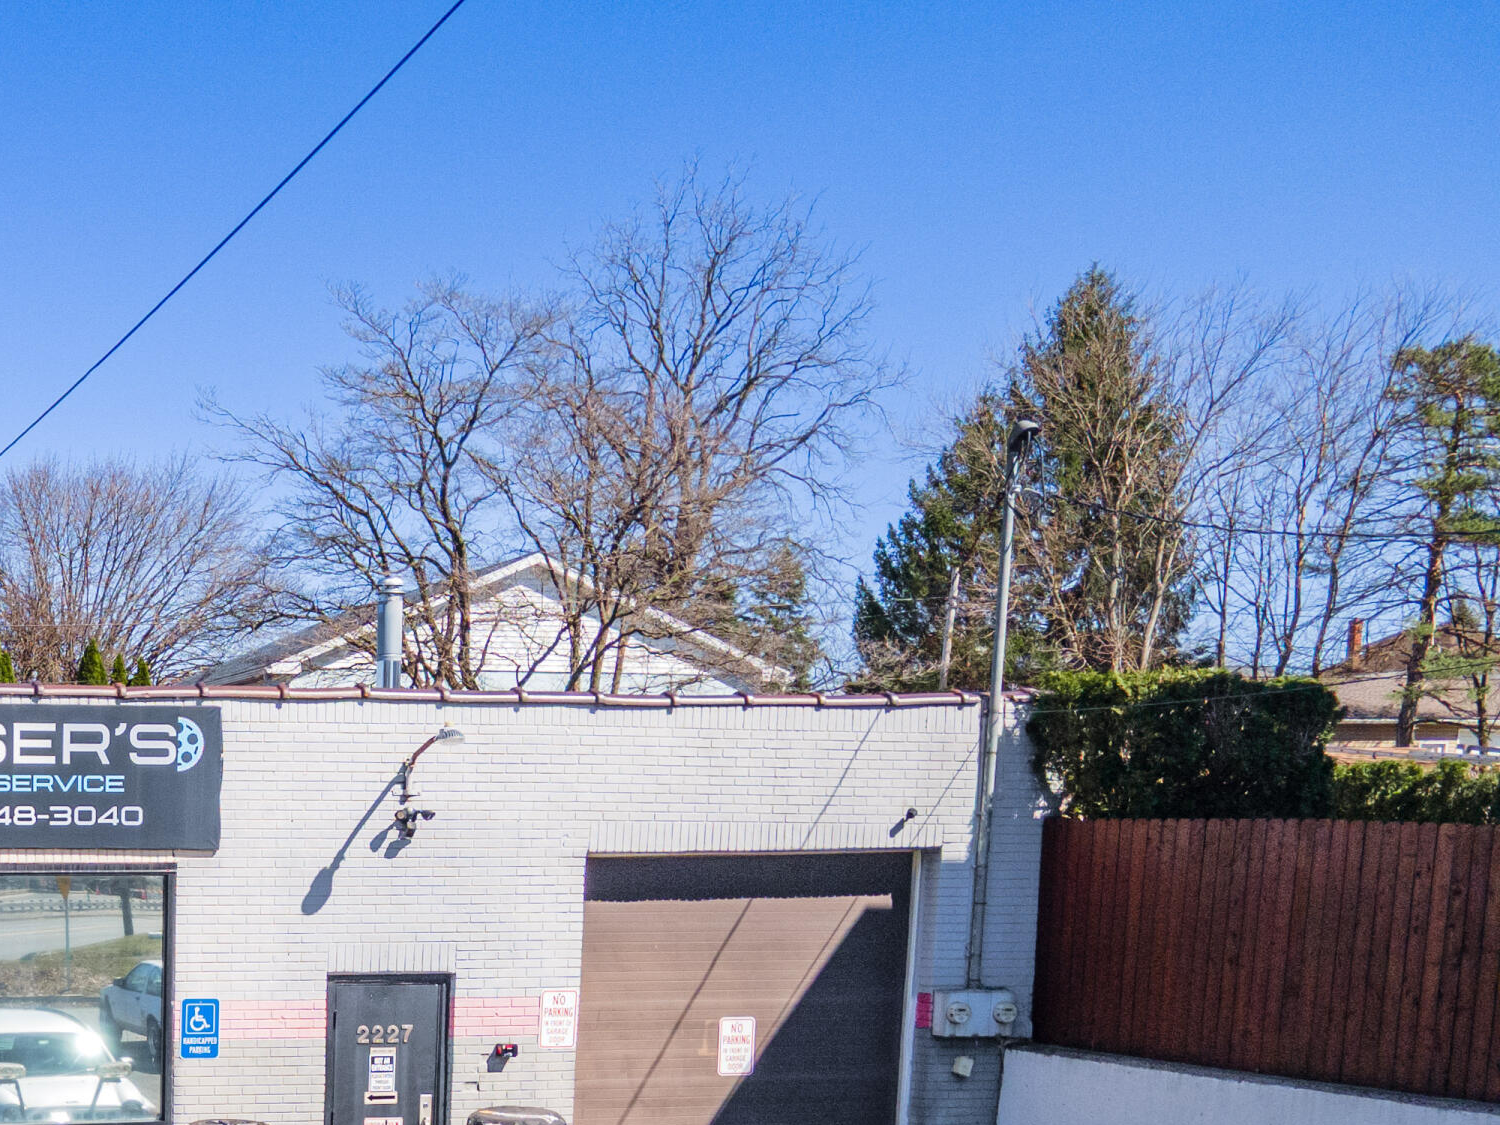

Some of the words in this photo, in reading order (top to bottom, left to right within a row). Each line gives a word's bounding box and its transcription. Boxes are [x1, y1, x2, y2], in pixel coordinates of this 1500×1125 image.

[552, 995, 565, 1006] NO
[544, 1008, 573, 1017] PARKING
[730, 1024, 744, 1033] NO
[356, 1024, 414, 1044] 2227
[182, 1037, 218, 1045] HANDICAPPED
[723, 1035, 750, 1044] PARKING
[188, 1046, 211, 1054] PARKING
